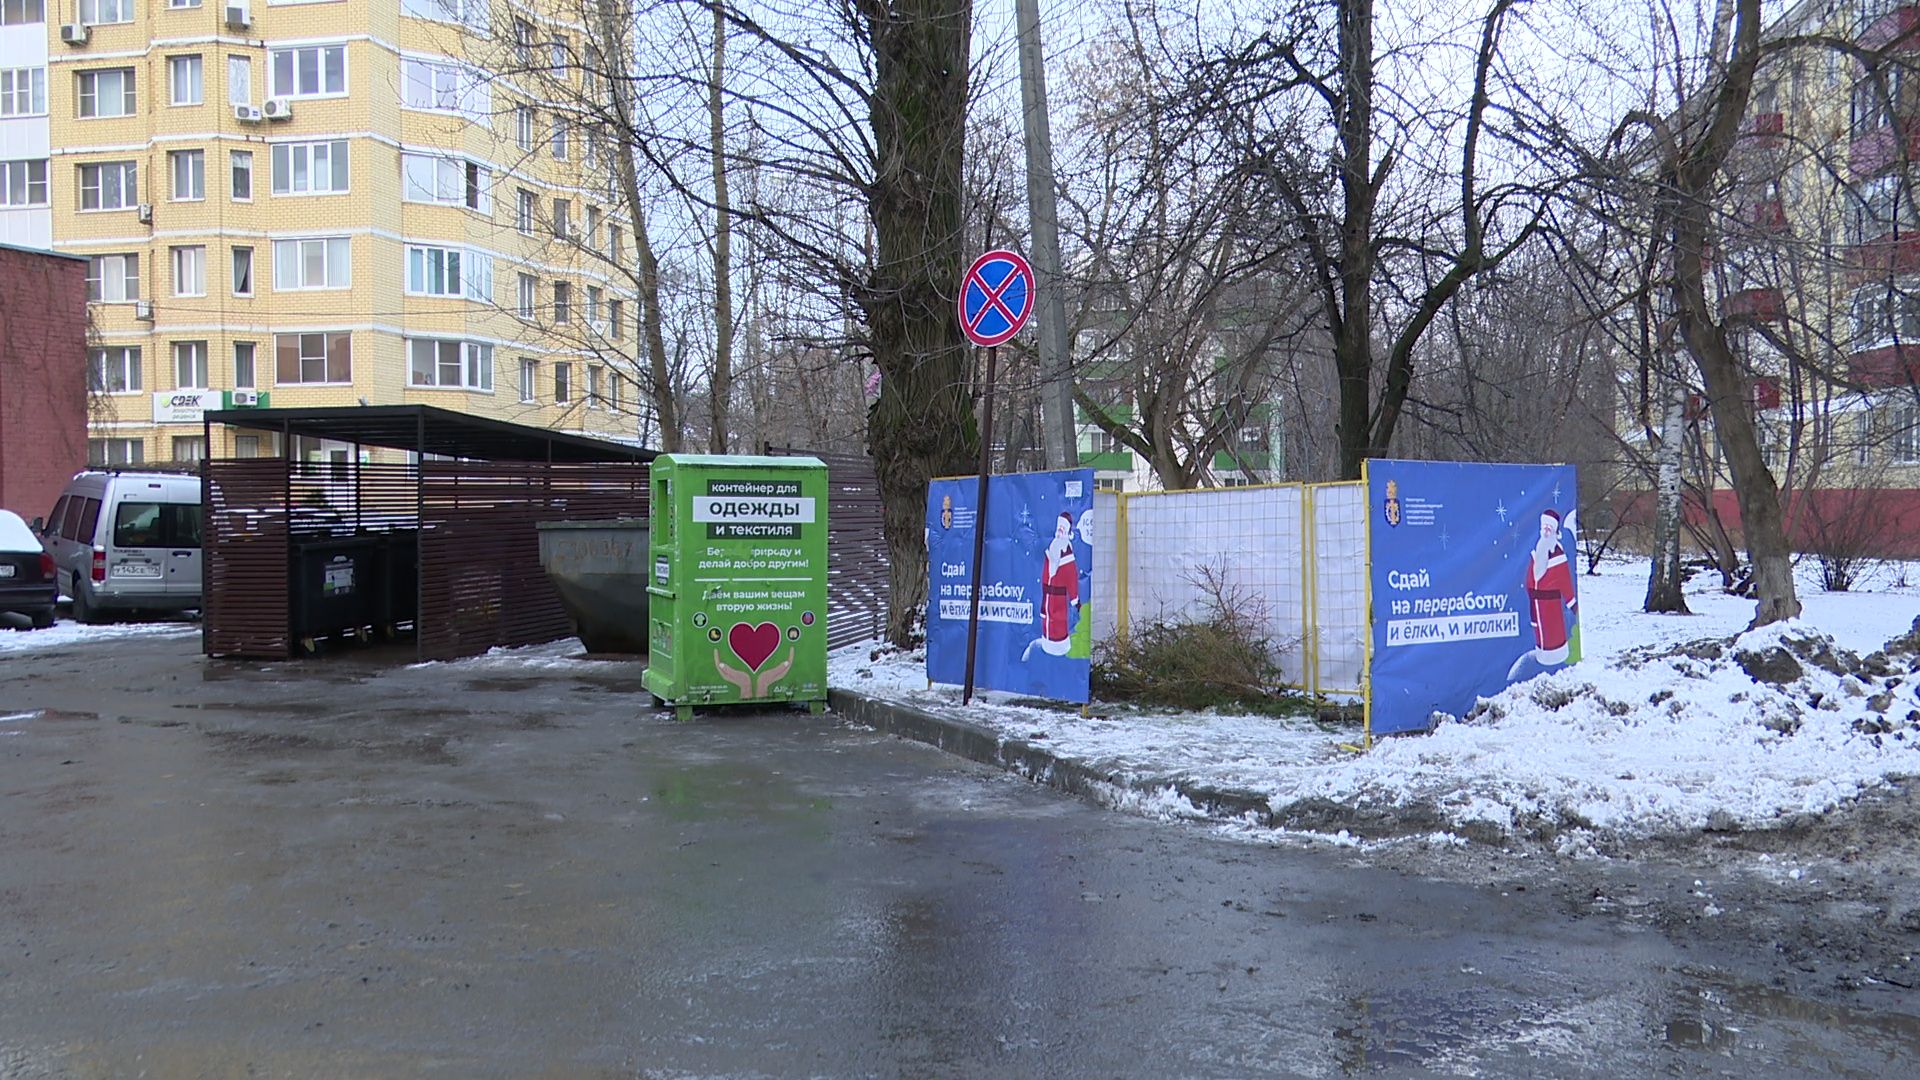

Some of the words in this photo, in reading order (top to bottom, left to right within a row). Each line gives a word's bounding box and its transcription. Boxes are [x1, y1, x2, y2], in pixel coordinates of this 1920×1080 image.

[711, 483, 775, 494] контейнер
[776, 485, 798, 494] для
[709, 502, 800, 518] одежды
[715, 526, 725, 535] и
[728, 526, 793, 535] текстиля
[698, 559, 732, 569] делай
[768, 559, 809, 569] другим!
[941, 561, 966, 578] Сдай
[1388, 568, 1430, 591] Сдай
[733, 591, 769, 599] вашим
[940, 584, 952, 597] на
[953, 581, 1025, 602] перработку
[716, 603, 755, 612] вторую
[756, 601, 792, 611] жизнь!
[1391, 599, 1411, 615] на
[1413, 590, 1508, 616] переработку
[980, 605, 989, 616] и
[1390, 626, 1399, 640] и
[1403, 621, 1445, 640] ёлки,
[1448, 622, 1459, 636] и
[1464, 614, 1517, 635] иголки!
